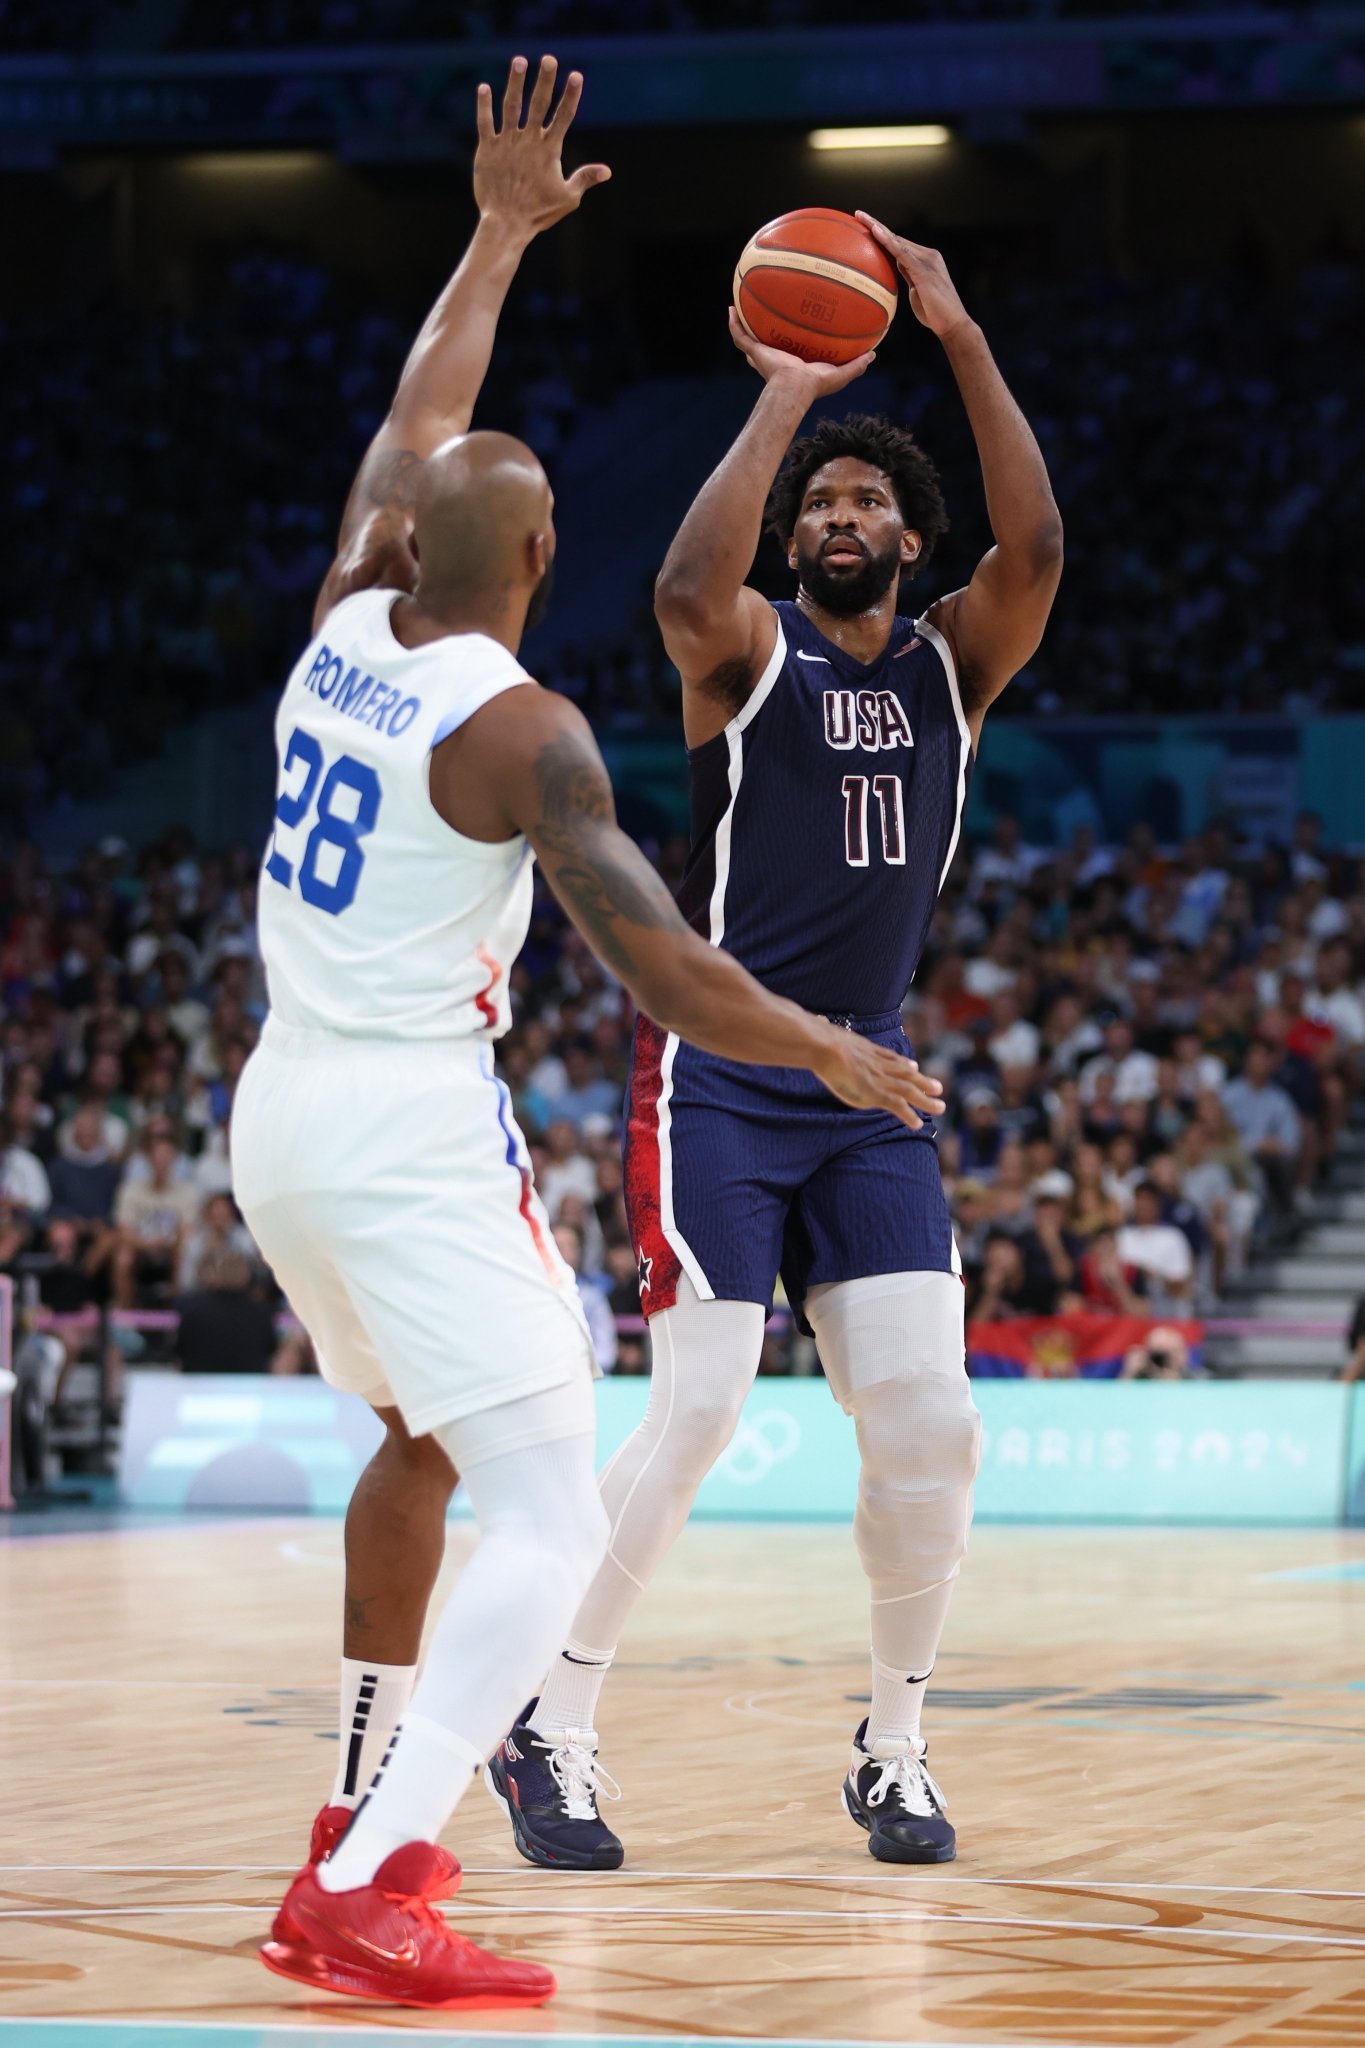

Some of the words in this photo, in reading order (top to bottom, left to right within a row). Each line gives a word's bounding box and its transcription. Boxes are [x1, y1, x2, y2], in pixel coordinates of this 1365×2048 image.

[800, 299, 836, 322] FIBA
[304, 644, 421, 738] ROMERO
[823, 690, 914, 752] USA
[265, 726, 383, 917] 28
[841, 774, 906, 867] 11
[982, 1427, 1131, 1471] ARIS
[1151, 1428, 1310, 1471] 2024
